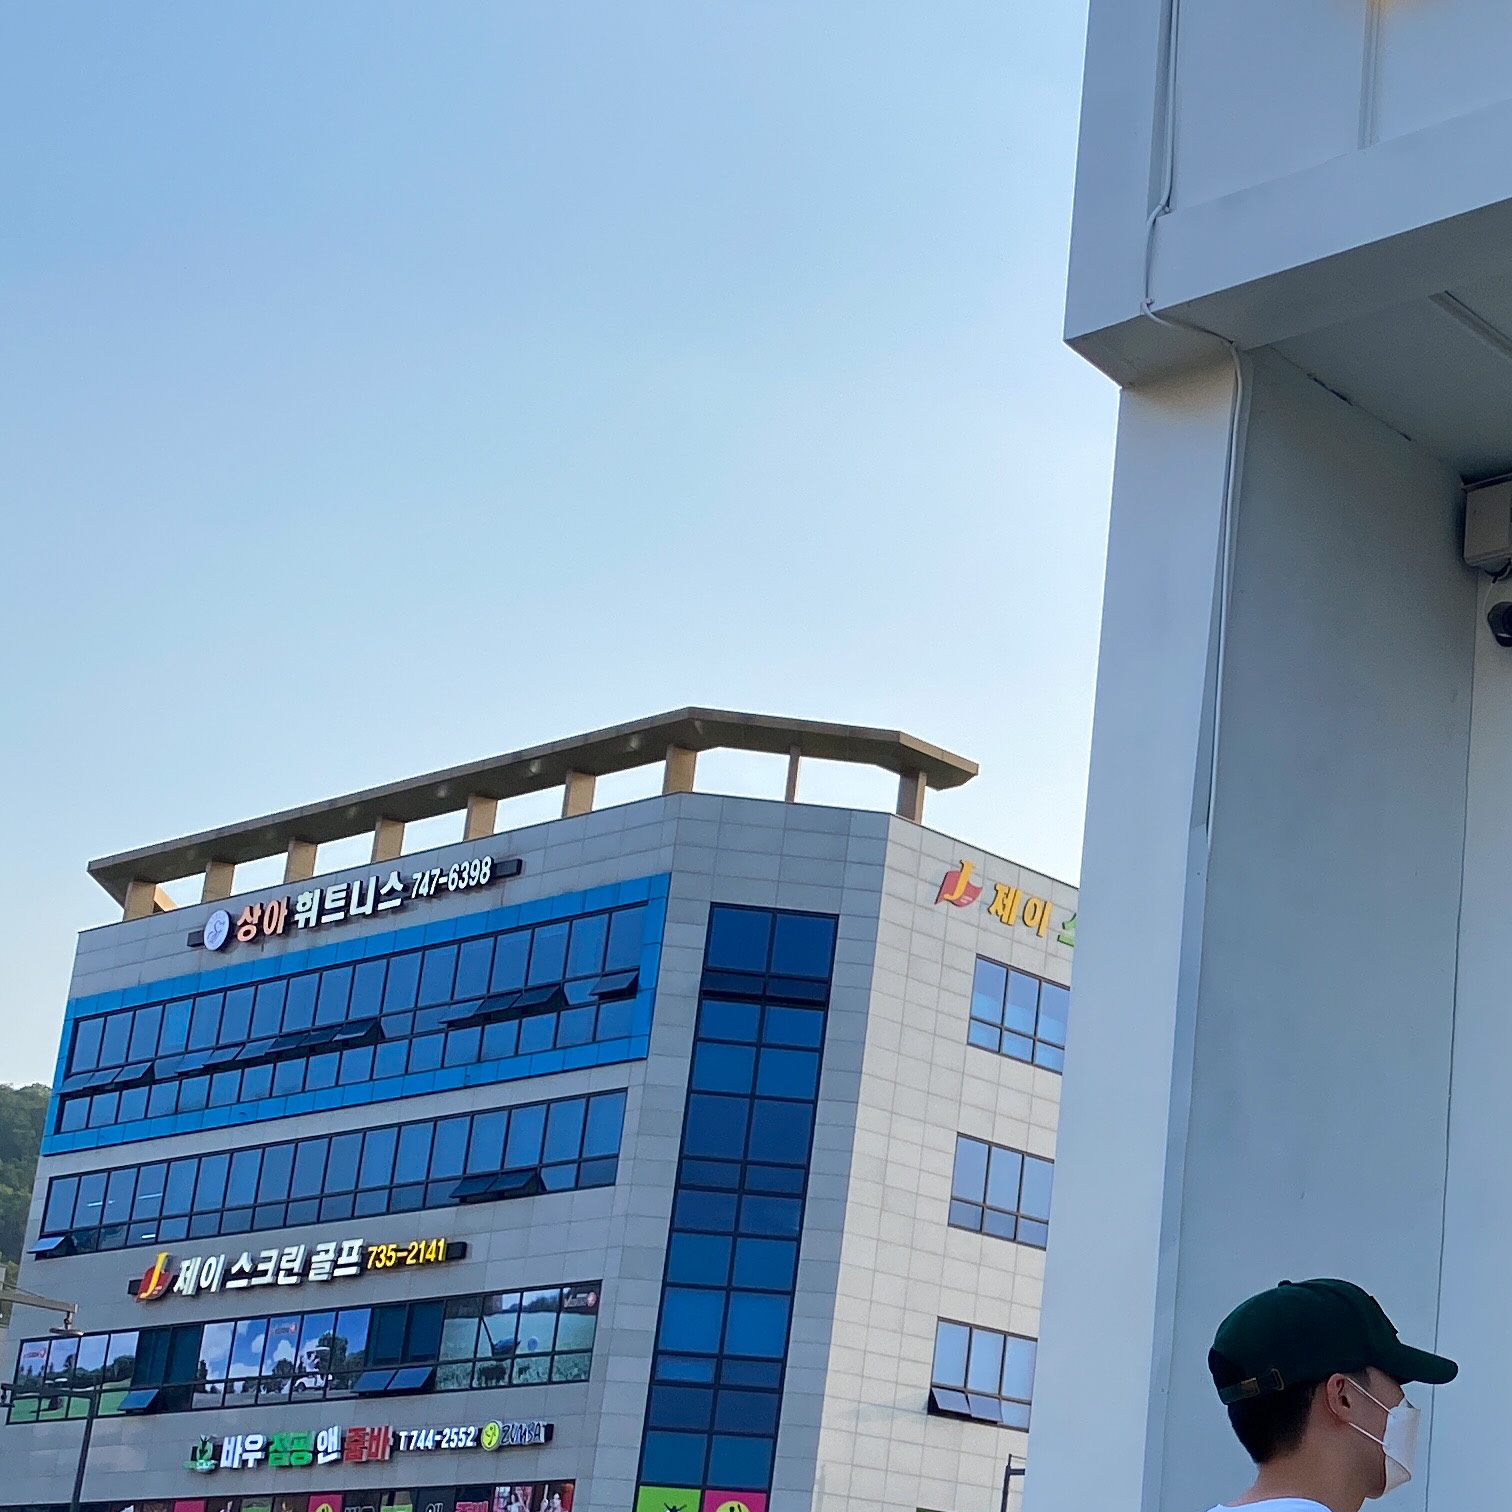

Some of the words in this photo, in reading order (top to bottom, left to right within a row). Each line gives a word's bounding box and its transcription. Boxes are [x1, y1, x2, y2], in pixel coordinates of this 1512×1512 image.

[236, 897, 288, 942] 상아
[294, 870, 403, 930] 휘트니스
[410, 856, 493, 899] 747-6398
[988, 882, 1053, 939] 제이
[173, 1253, 226, 1296] 제이
[226, 1243, 307, 1288] 스크린
[309, 1238, 364, 1281] 골프
[367, 1237, 447, 1269] 735-2141
[220, 1434, 267, 1469] 바우
